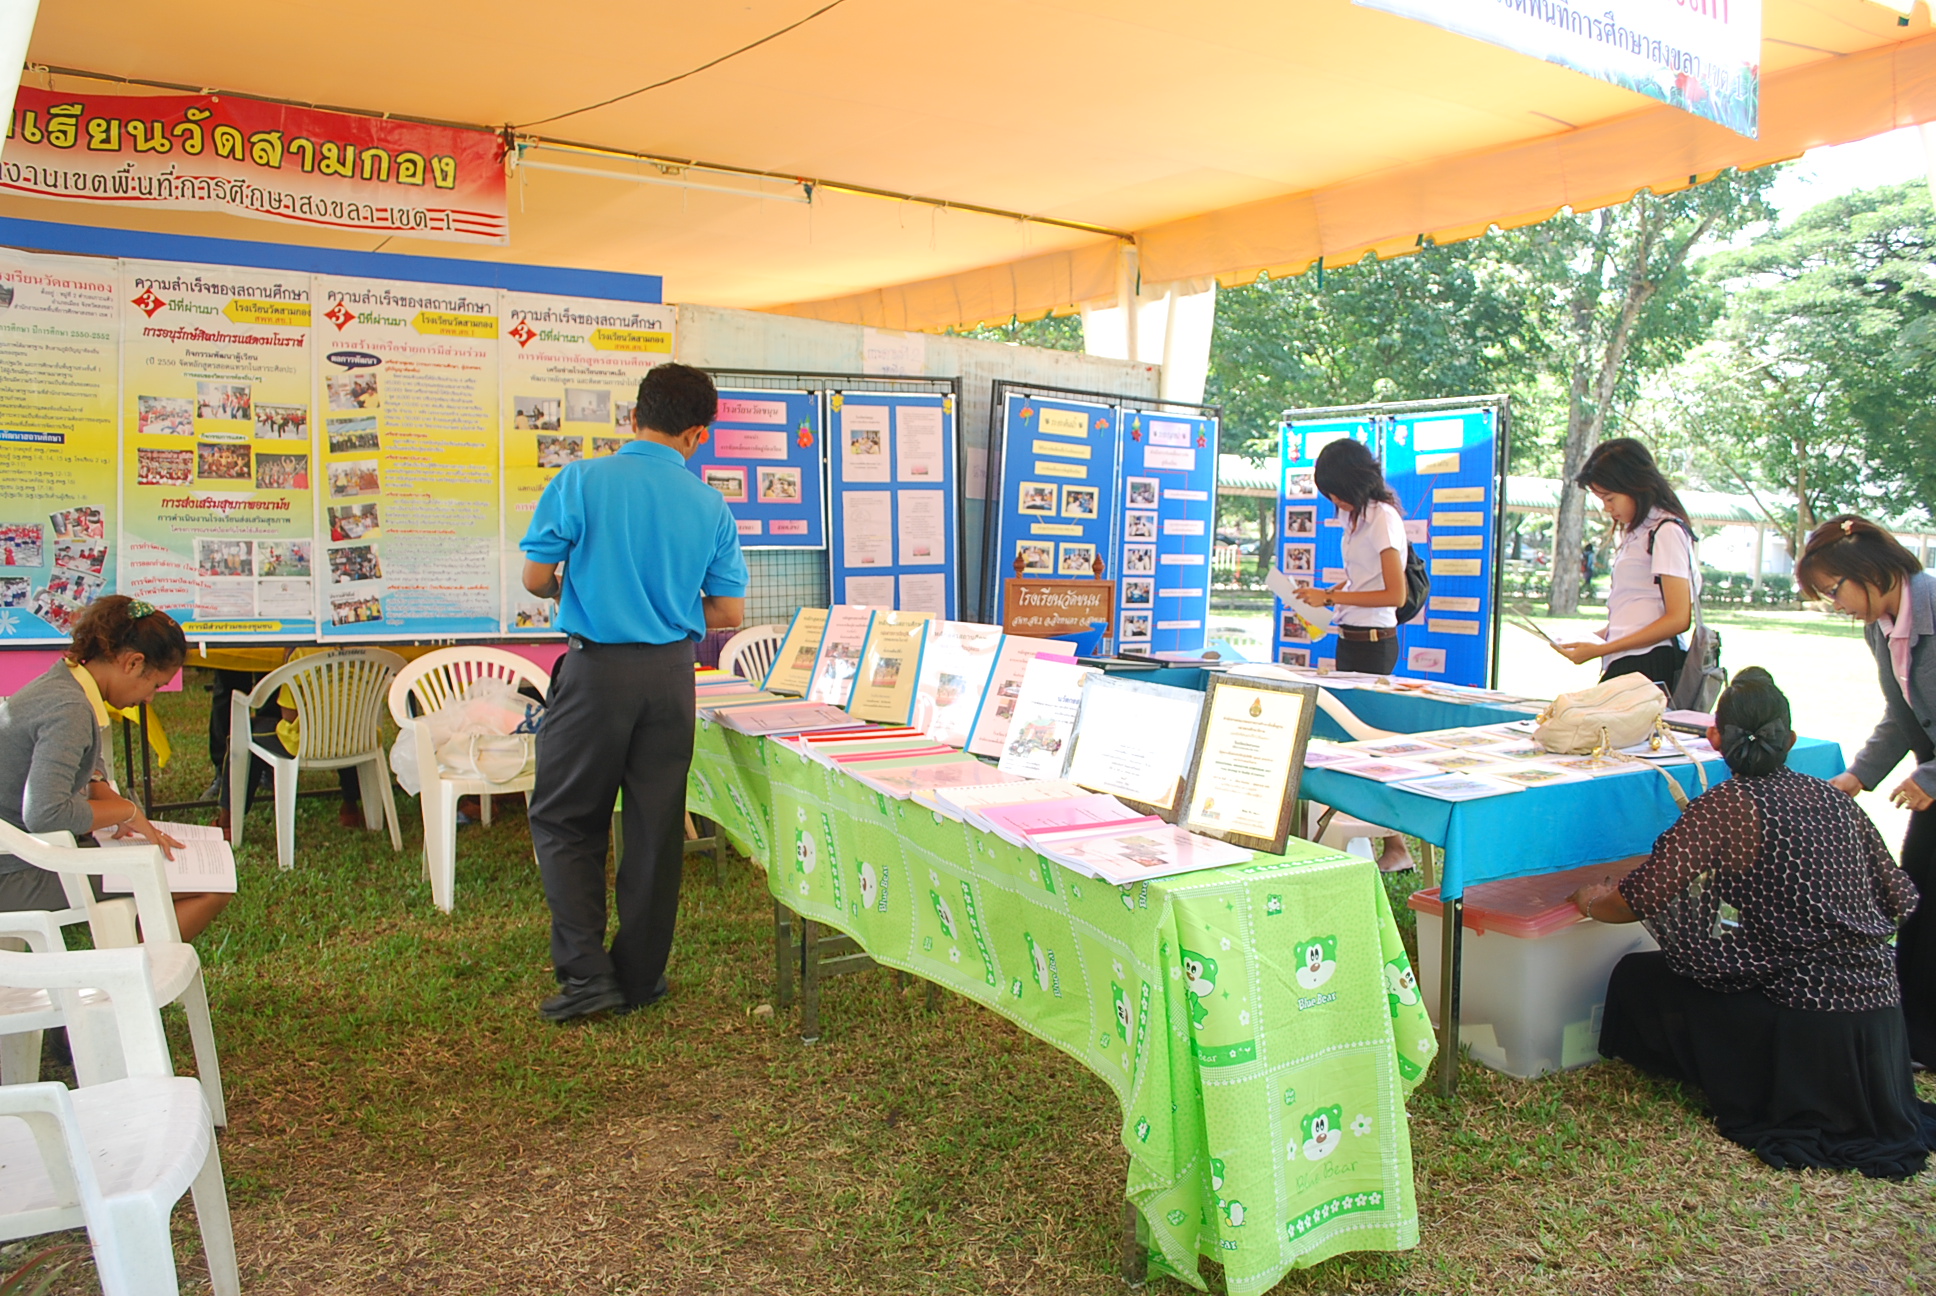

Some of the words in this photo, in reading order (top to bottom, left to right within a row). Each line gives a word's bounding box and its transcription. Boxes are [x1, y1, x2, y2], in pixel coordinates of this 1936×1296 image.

[389, 207, 427, 229] เขต
[444, 211, 452, 230] 1
[135, 276, 309, 301] ความสำเร็จของสถานศึกษา
[140, 292, 155, 310] 3
[168, 298, 219, 315] ปีที่ผ่านมา
[234, 300, 311, 317] โรงเรียนวัดสามกอง
[328, 289, 491, 314] ความสำเร็จของสถานศึกษา
[332, 305, 346, 324] 3
[358, 311, 407, 327] ปีที่ผ่านมา
[421, 313, 493, 329] โรงเรียนวัดสามกอง
[511, 307, 662, 330] ความสำเร็จของสถานศึกษา
[515, 324, 528, 342] 3
[539, 328, 585, 344] ปีที่ผ่านมา
[879, 887, 888, 912] Blue
[1297, 996, 1316, 1011] Blue
[1316, 991, 1337, 1006] Bear
[1296, 1174, 1320, 1194] Blue
[1323, 1160, 1358, 1178] Bear
